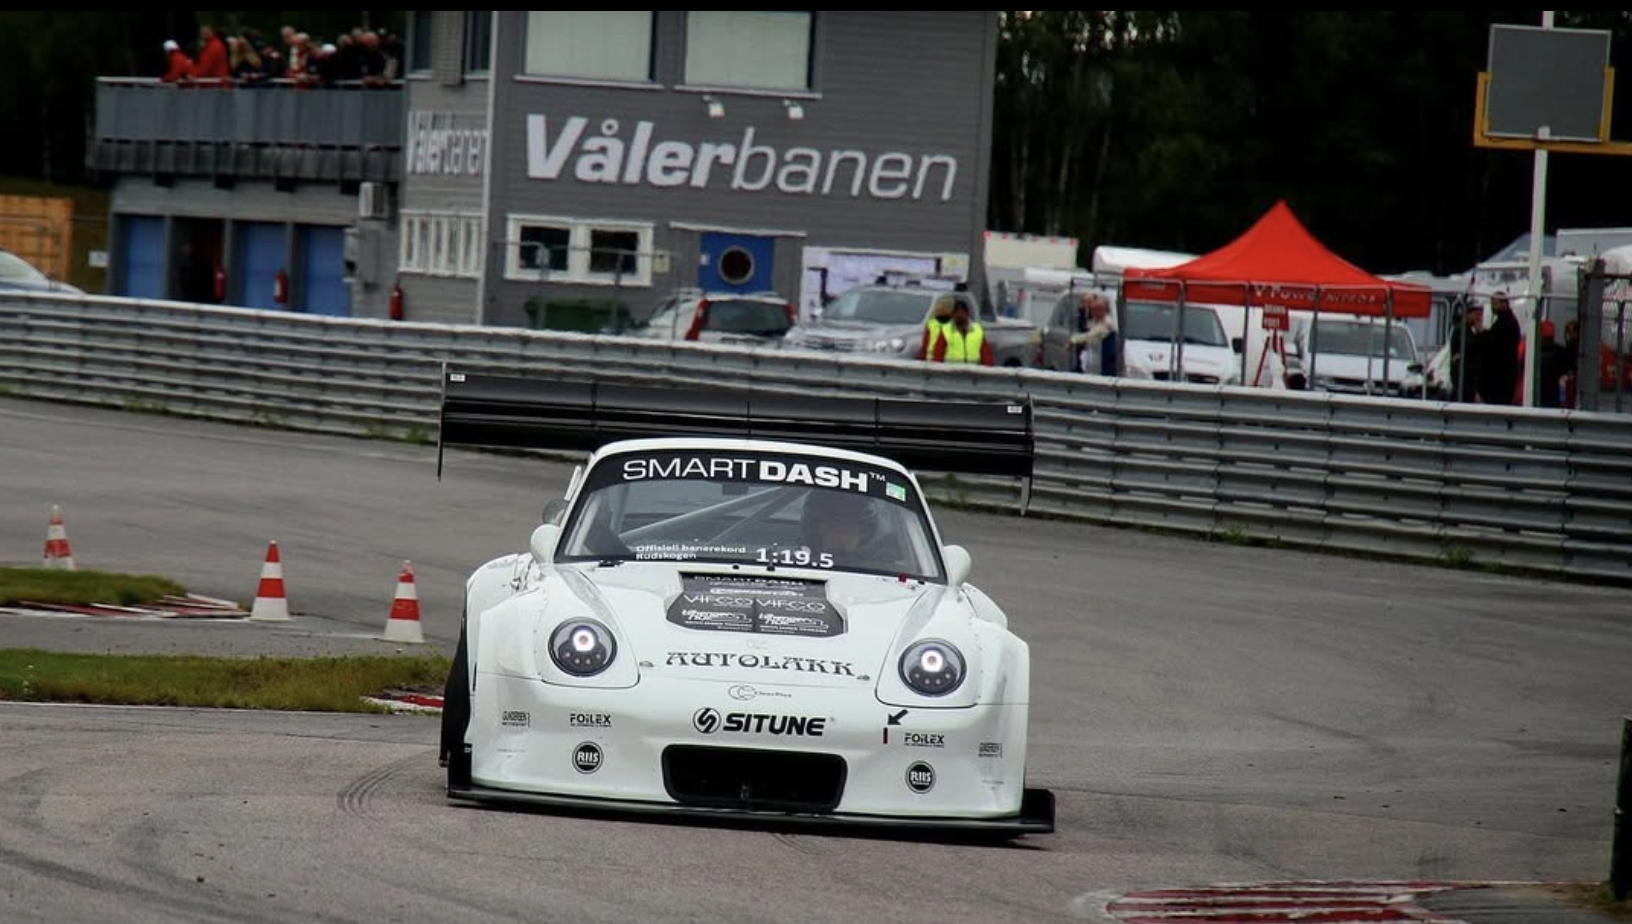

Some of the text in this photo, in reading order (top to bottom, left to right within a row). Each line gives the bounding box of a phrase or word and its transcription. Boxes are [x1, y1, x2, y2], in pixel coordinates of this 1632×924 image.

[526, 113, 957, 201] Vålerbanen
[755, 547, 834, 568] 1:19.5
[665, 652, 856, 677] AUTOLAKK
[722, 712, 827, 737] SITUNE
